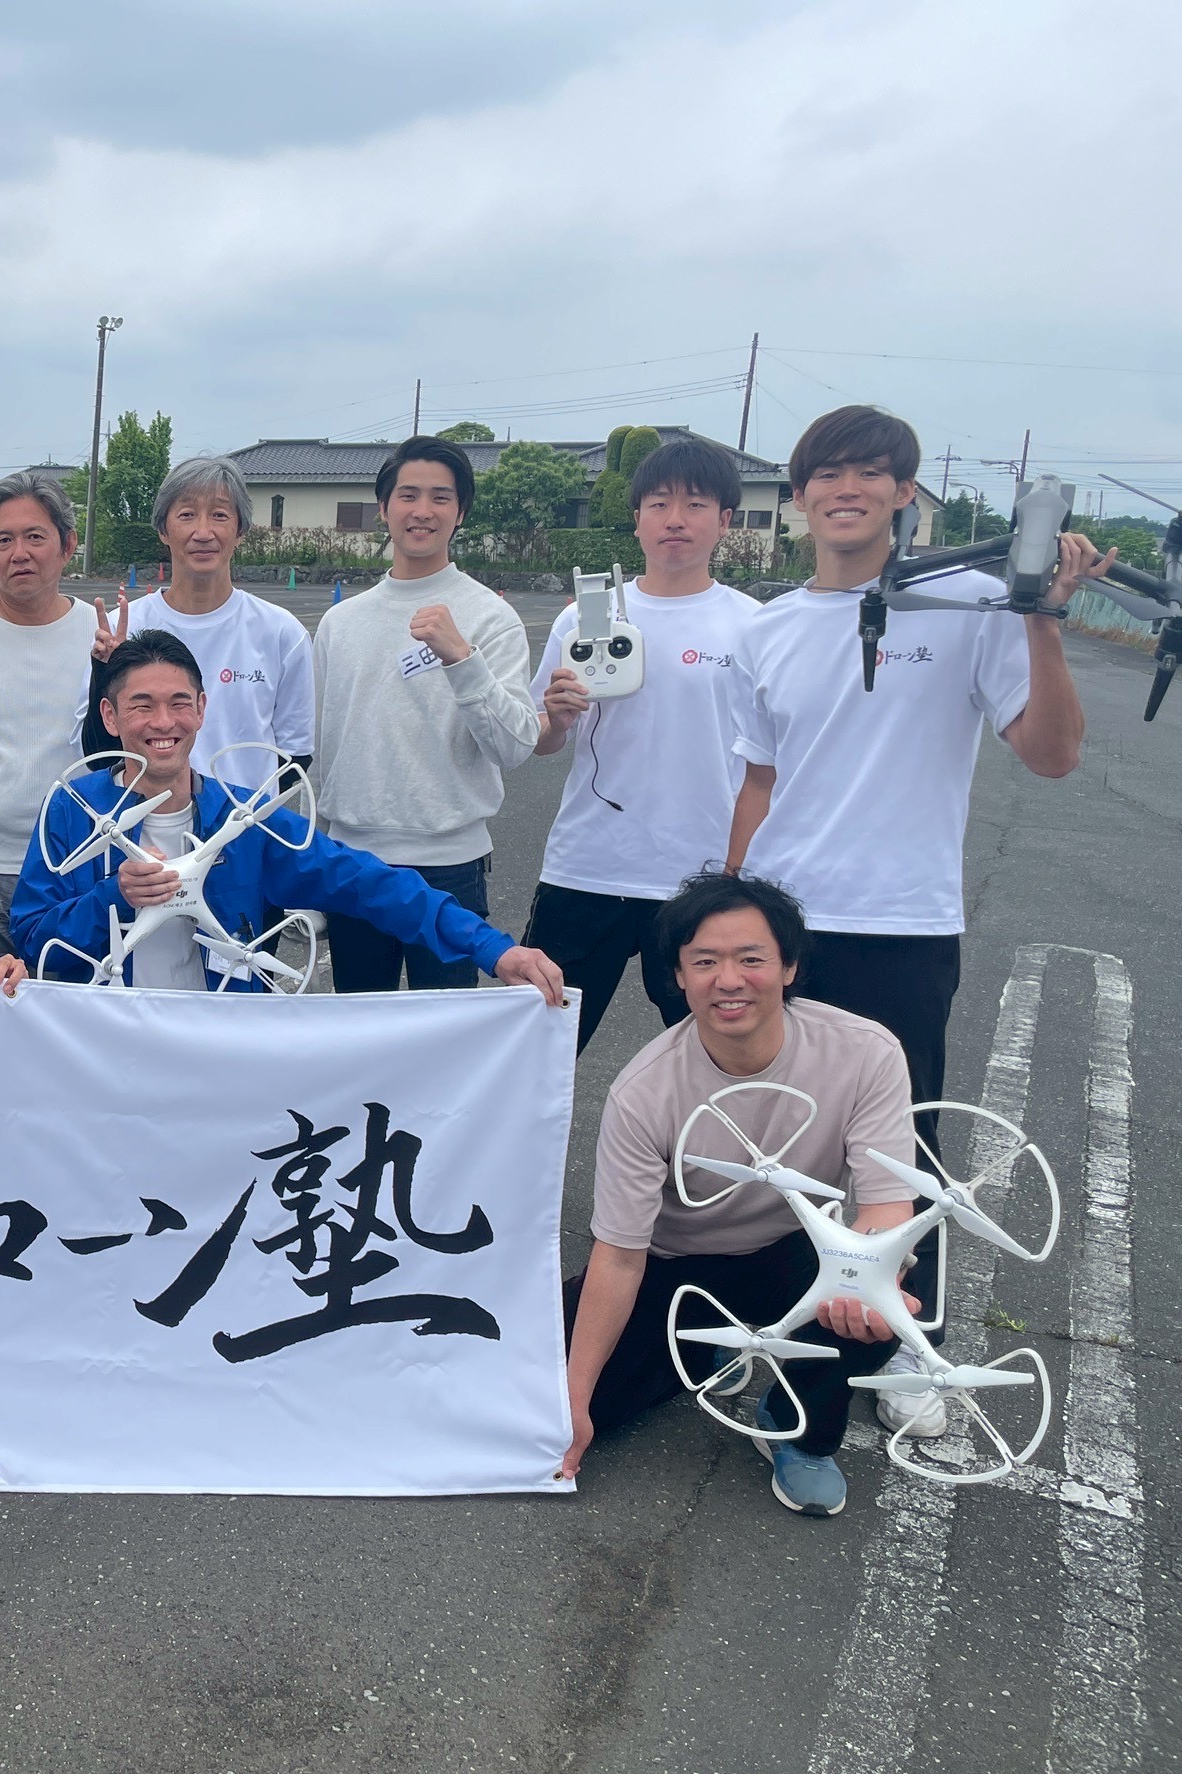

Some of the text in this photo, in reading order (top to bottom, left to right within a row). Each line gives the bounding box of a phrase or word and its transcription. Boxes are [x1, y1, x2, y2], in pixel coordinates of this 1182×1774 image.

[885, 646, 933, 664] ドローン塾
[233, 670, 265, 682] ドローン塾
